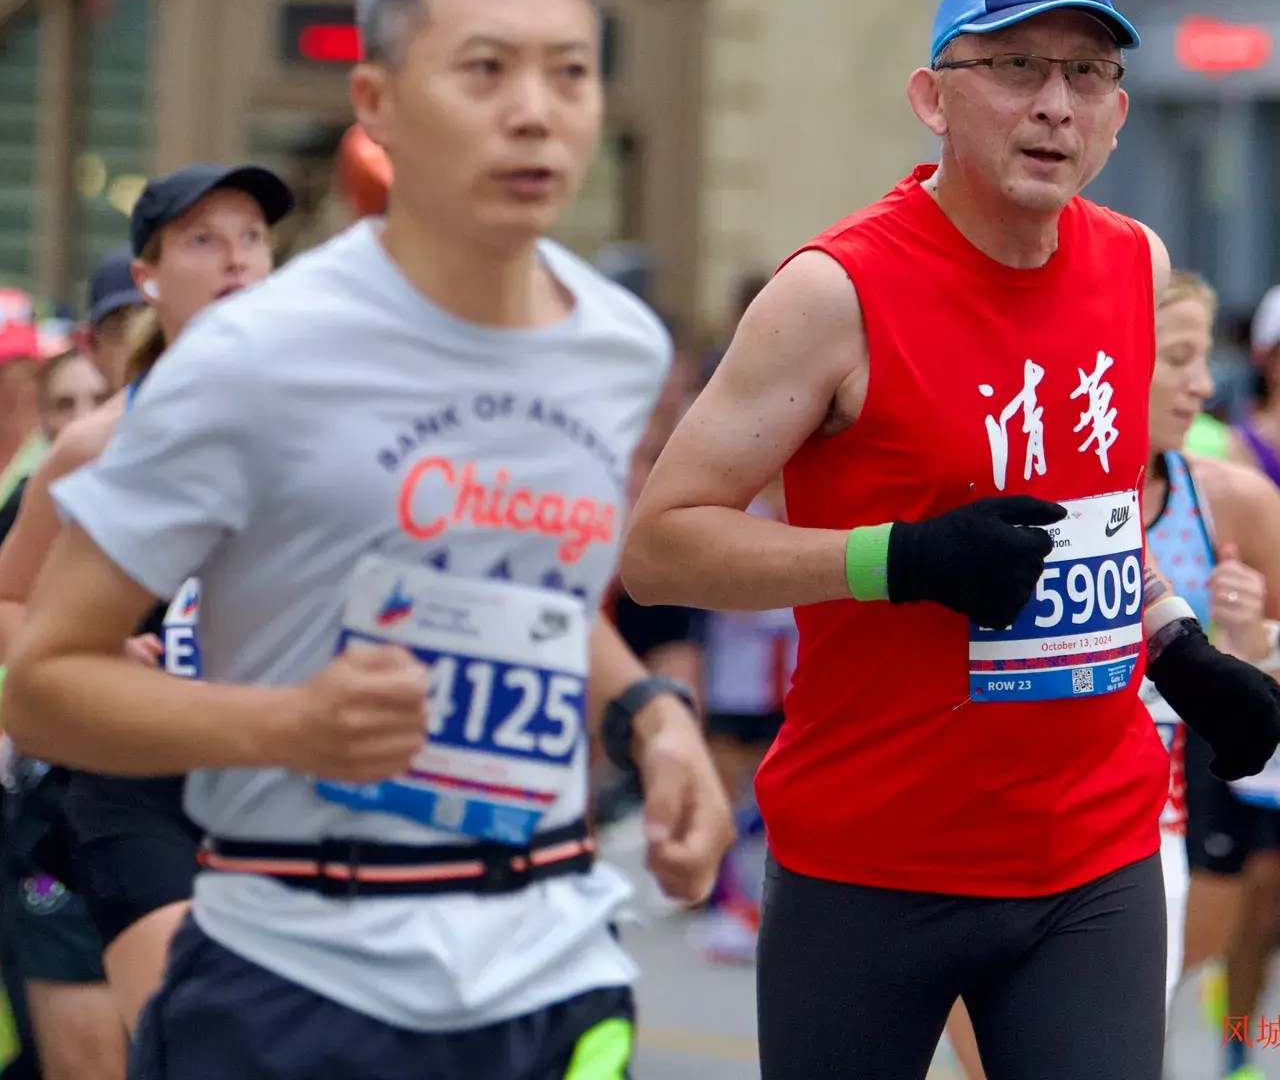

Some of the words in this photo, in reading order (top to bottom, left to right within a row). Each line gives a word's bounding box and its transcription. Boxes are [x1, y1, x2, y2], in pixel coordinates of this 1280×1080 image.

[377, 404, 461, 472] BANK
[473, 393, 517, 422] OF
[1110, 505, 1131, 523] RUN
[165, 626, 198, 677] E
[1041, 639, 1077, 652] October
[1079, 637, 1093, 648] 13,
[1094, 634, 1113, 646] 2024
[988, 680, 1015, 691] ROW
[1018, 680, 1032, 690] 23
